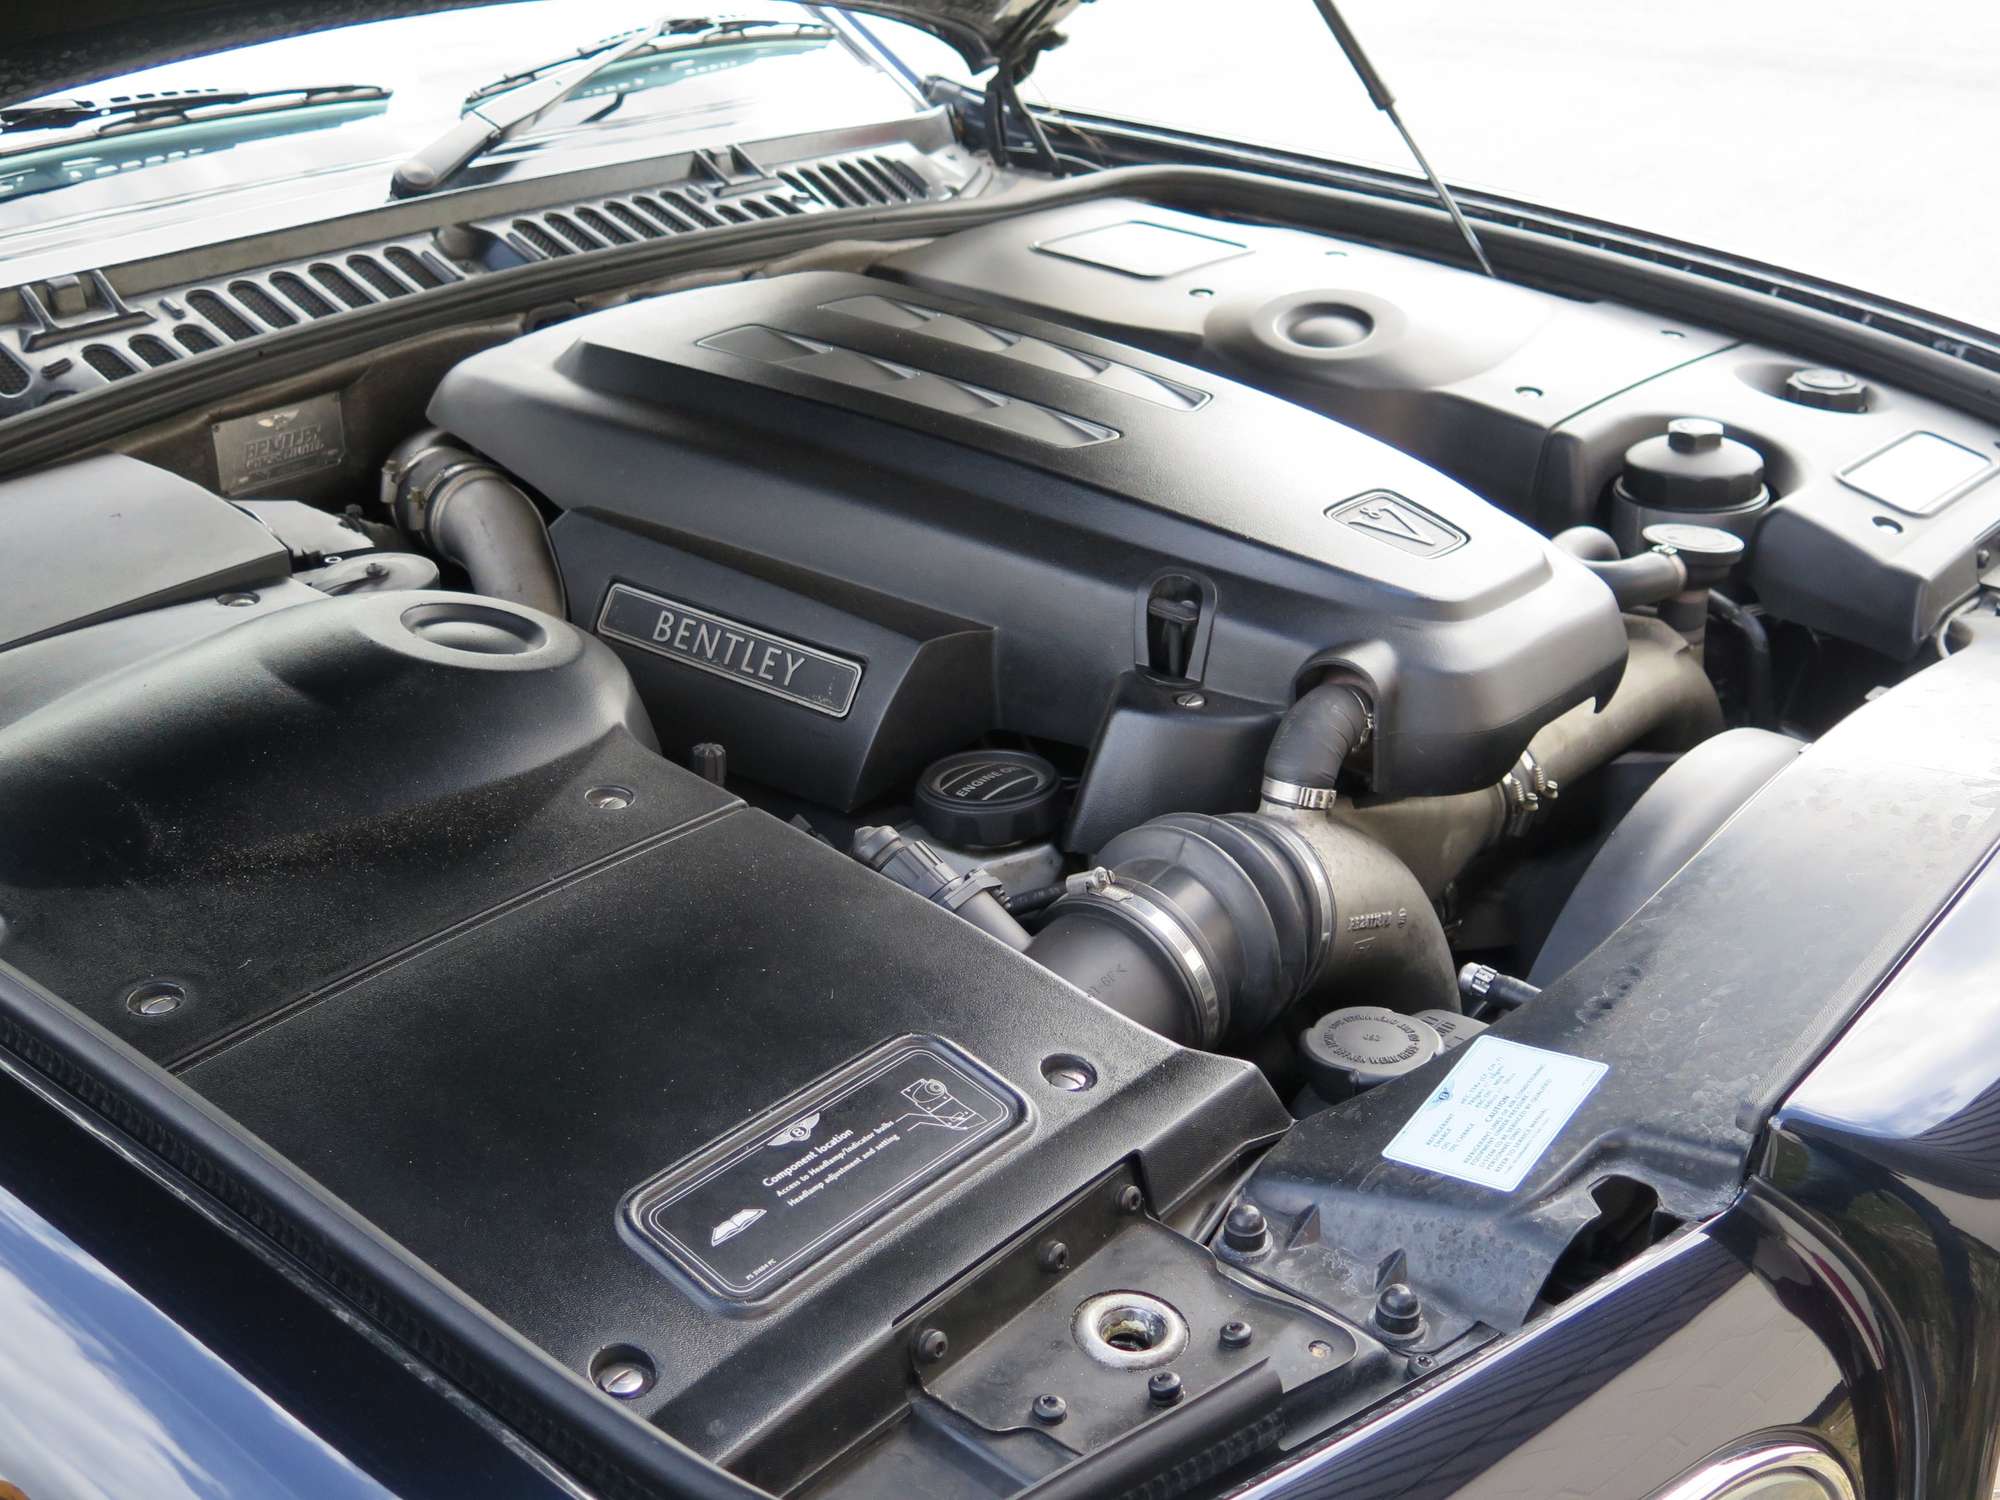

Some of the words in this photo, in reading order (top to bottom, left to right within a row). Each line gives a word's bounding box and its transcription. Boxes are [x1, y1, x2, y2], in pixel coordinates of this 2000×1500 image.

[652, 611, 805, 686] BENTLEY
[956, 771, 1002, 797] ENGINE
[1483, 1095, 1511, 1122] CAUTION
[763, 1151, 818, 1186] Component
[814, 1129, 854, 1153] location
[776, 1180, 800, 1197] Access
[873, 1121, 894, 1134] bulbs
[787, 1182, 824, 1206] Headlamp
[824, 1158, 862, 1183] adjustment
[862, 1147, 876, 1159] and
[875, 1134, 900, 1151] setting
